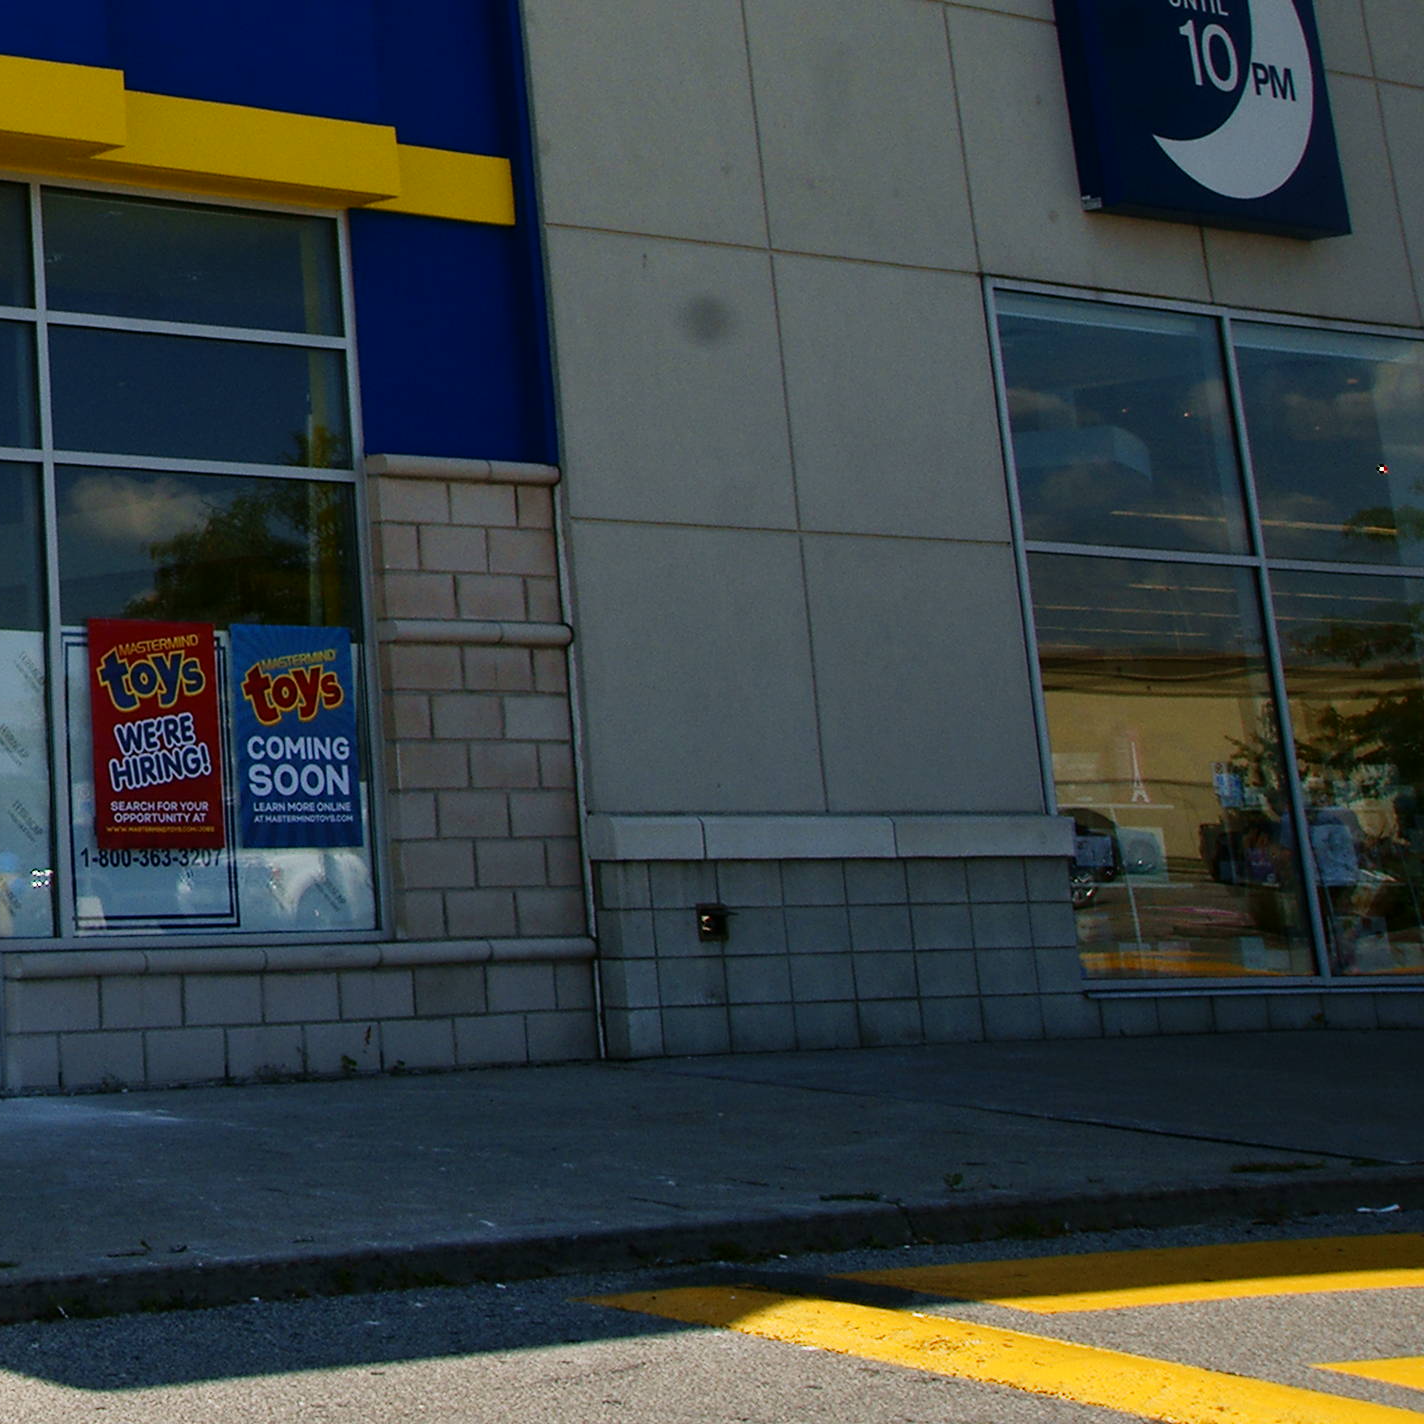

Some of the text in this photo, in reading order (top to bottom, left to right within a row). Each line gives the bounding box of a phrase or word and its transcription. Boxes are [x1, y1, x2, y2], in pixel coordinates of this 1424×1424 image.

[1179, 19, 1296, 102] 10 PM
[117, 633, 199, 657] MASTERMIND
[259, 648, 337, 672] MASTERMIND
[96, 644, 206, 712] toys
[240, 661, 345, 727] toys
[113, 712, 196, 756] WE'RE
[247, 735, 350, 761] COMING
[108, 742, 212, 793] HIRING!
[248, 763, 351, 797] SOON
[110, 801, 209, 813] SEARCH FOR YOUR
[113, 812, 207, 824] OPPORTUNITY AT
[253, 801, 352, 813] LEARN MORE ONLINE
[253, 813, 265, 824] AT
[80, 848, 222, 868] 1-800-363-3207
